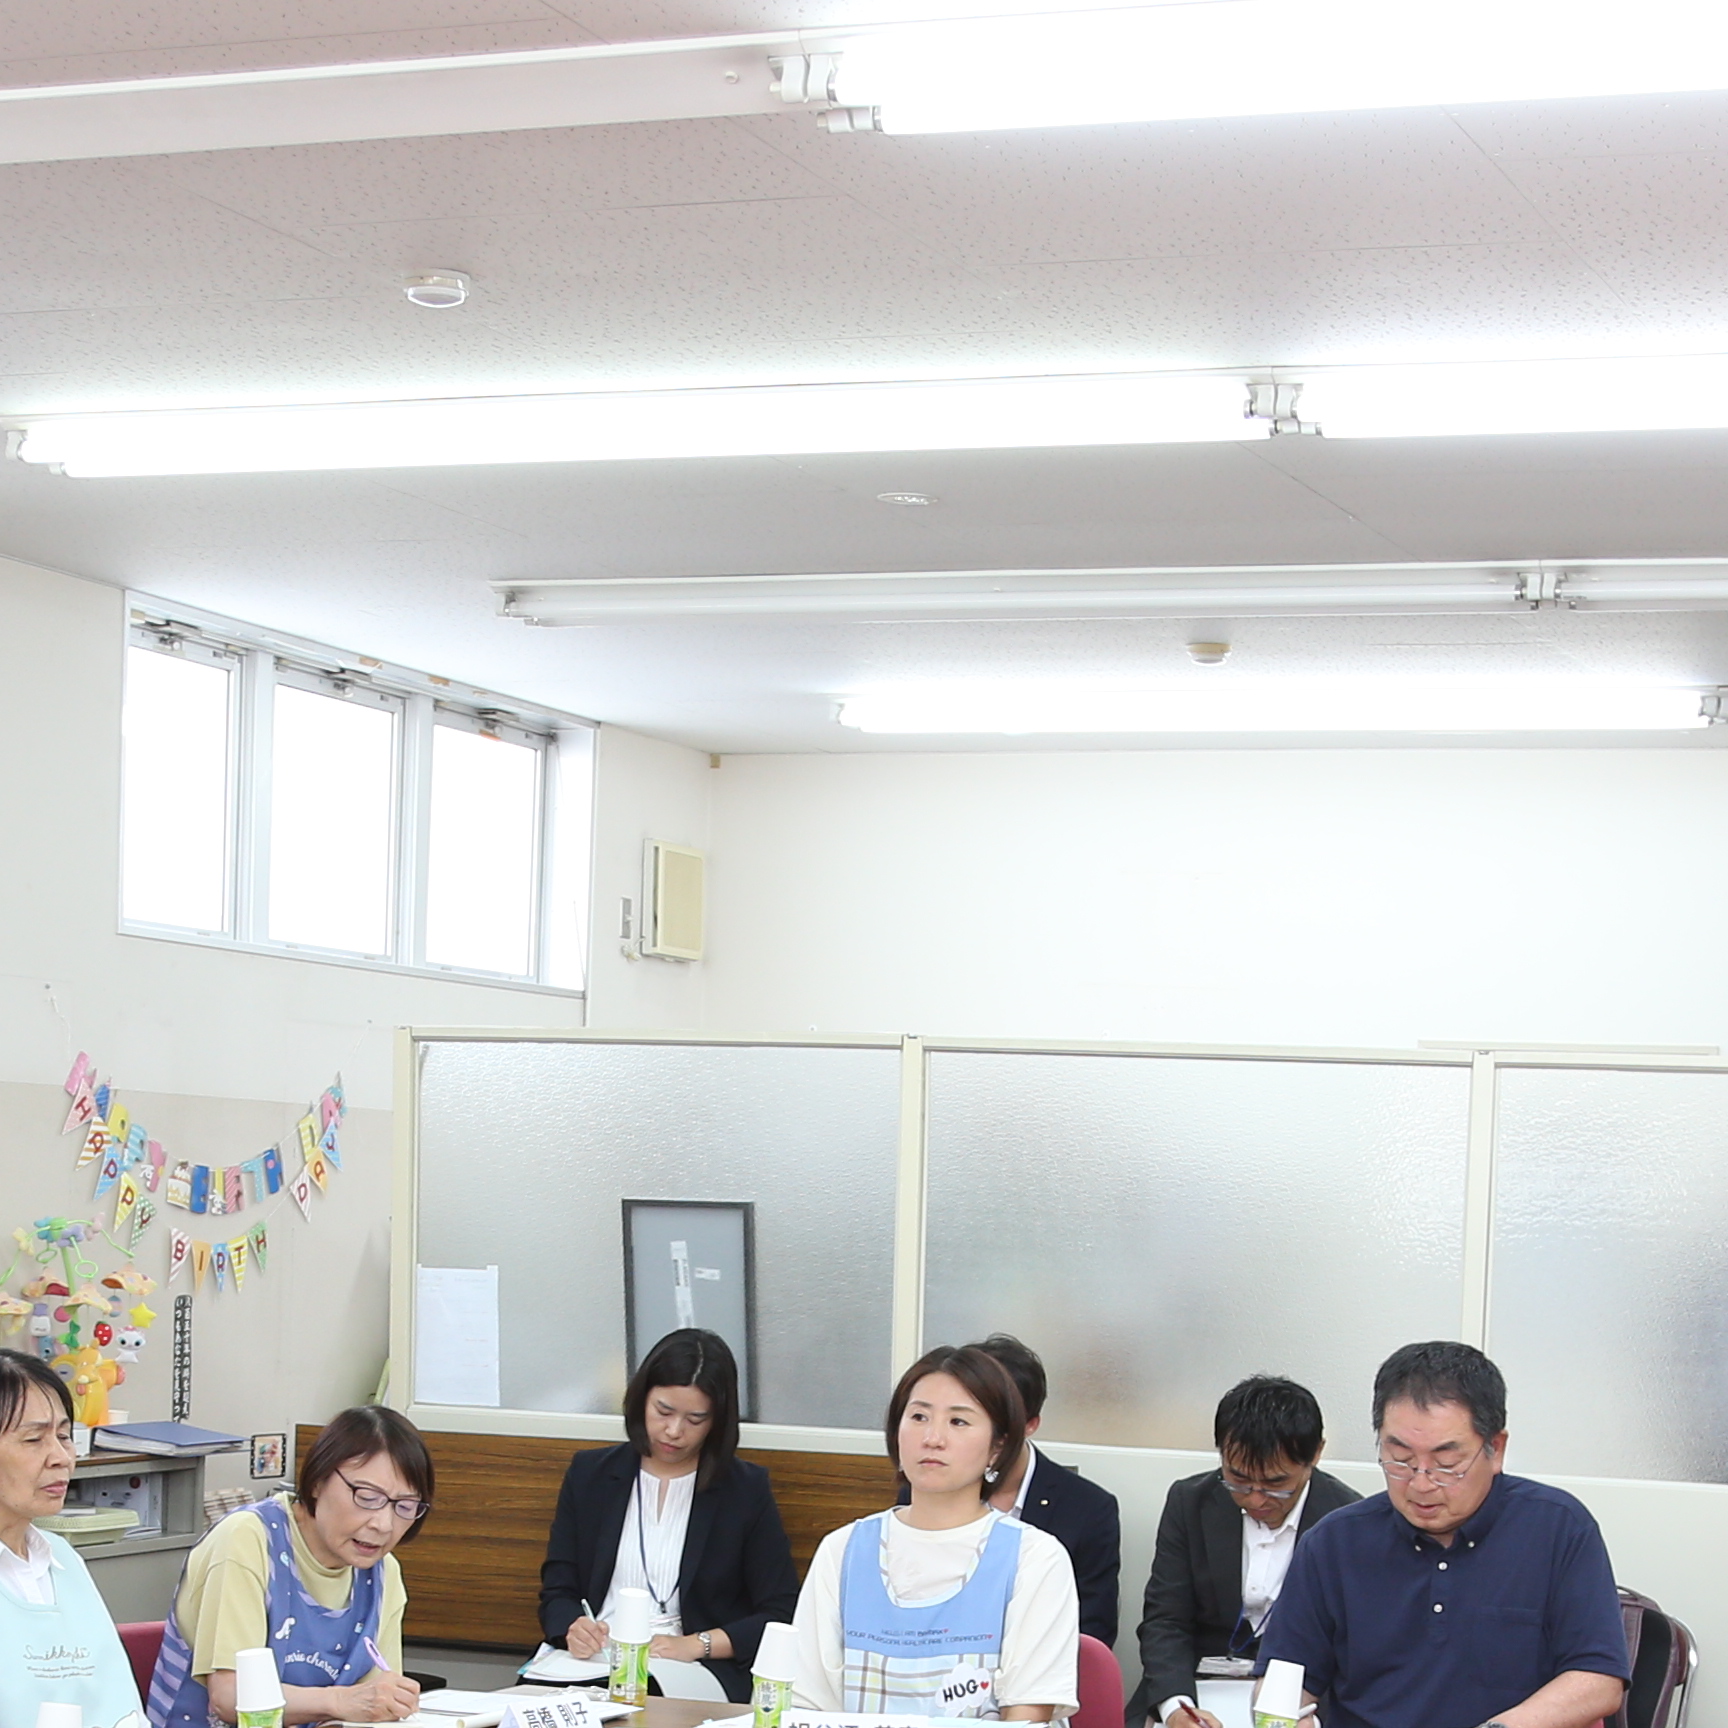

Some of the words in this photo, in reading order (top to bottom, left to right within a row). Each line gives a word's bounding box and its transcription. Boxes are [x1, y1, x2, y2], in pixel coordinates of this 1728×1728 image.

[174, 1229, 267, 1272] BIRTH
[942, 1679, 979, 1703] HUG
[557, 1701, 589, 1728] 則子
